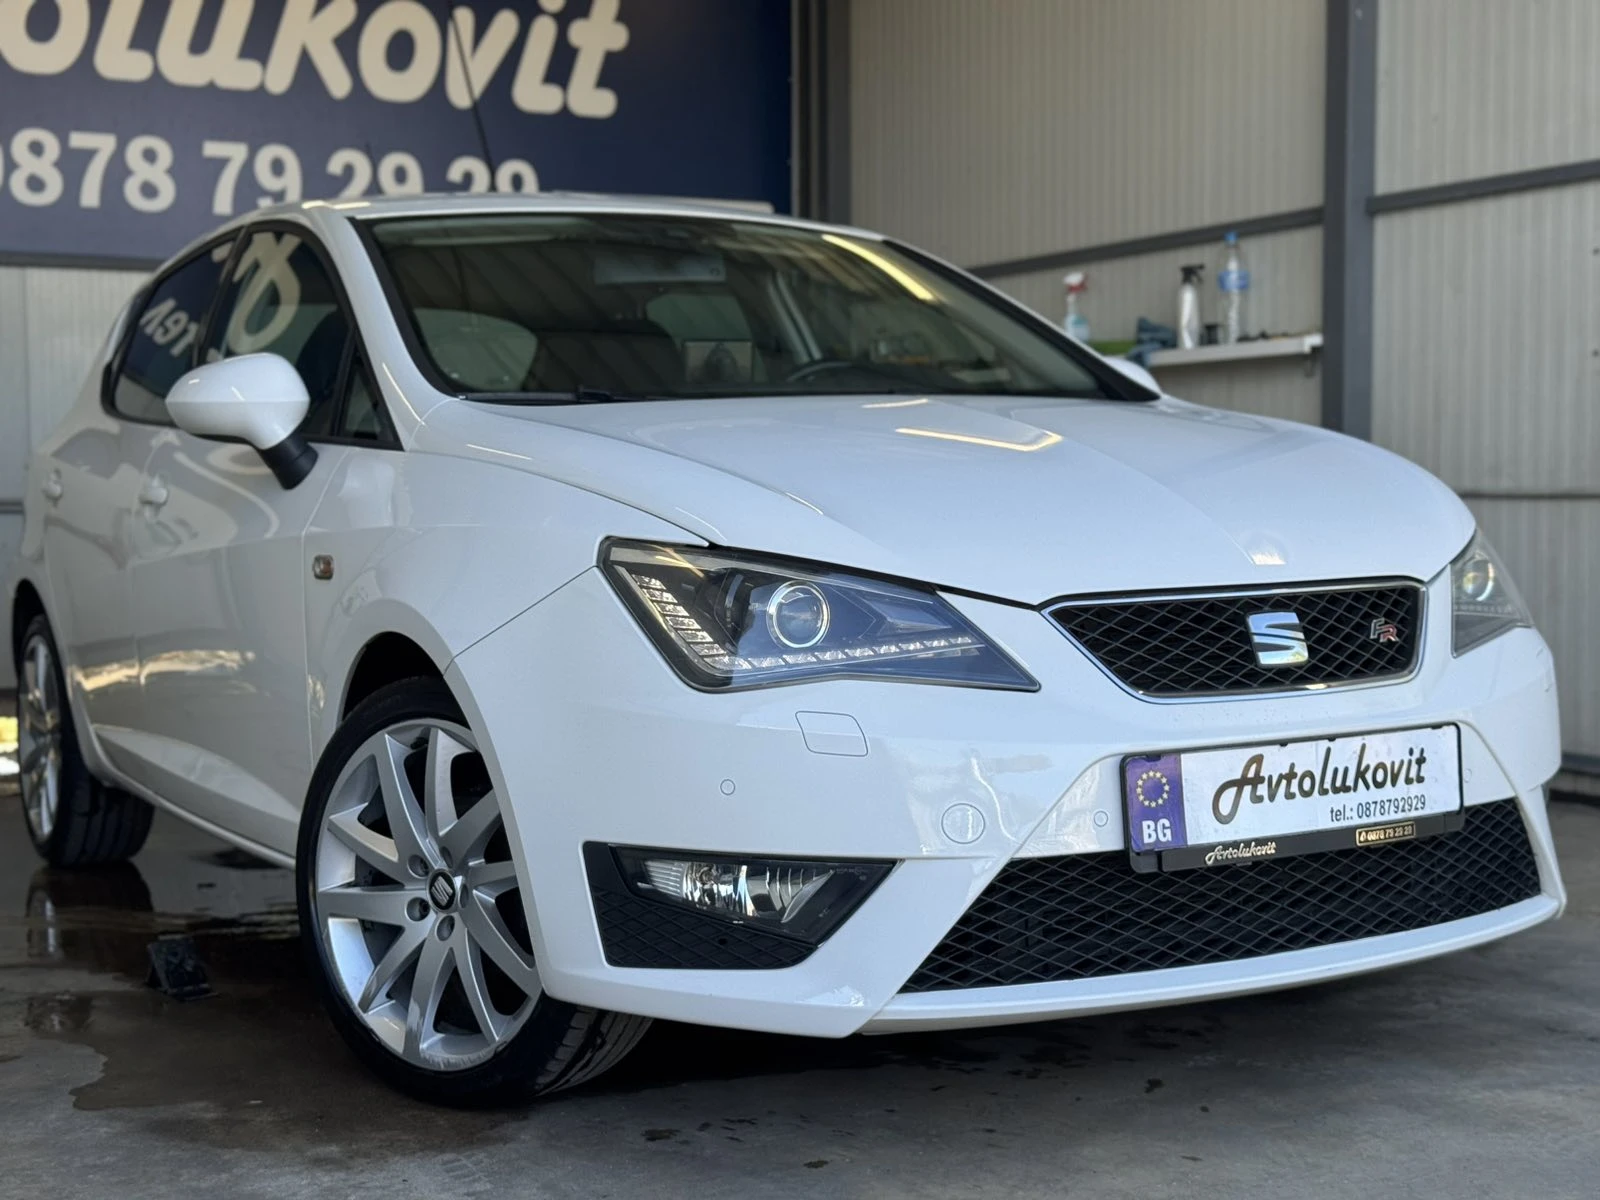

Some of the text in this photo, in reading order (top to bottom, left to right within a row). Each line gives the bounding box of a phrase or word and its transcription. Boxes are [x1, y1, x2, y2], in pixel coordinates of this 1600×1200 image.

[0, 128, 176, 214] 878
[202, 140, 303, 216] 79
[1369, 617, 1399, 642] FR
[1212, 743, 1427, 825] Avtolukovit
[1330, 794, 1426, 822] tel.: 0878792929
[1142, 819, 1172, 844] BG
